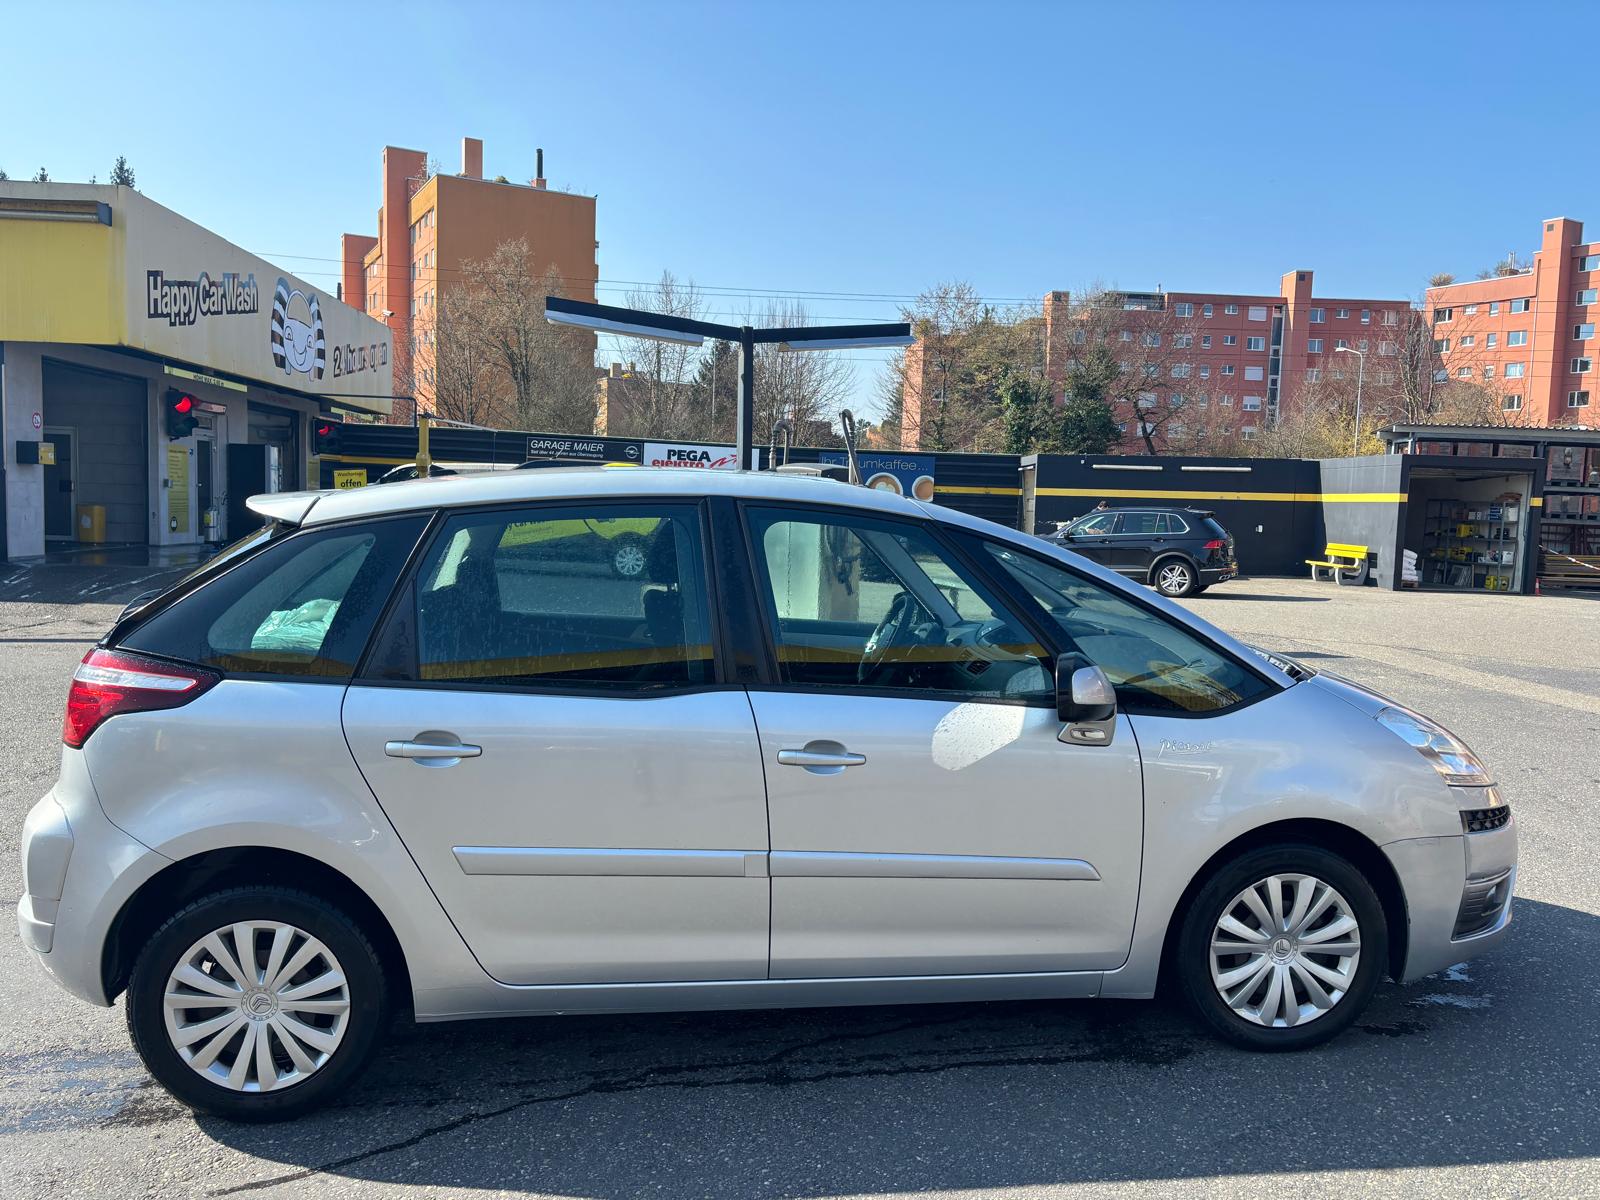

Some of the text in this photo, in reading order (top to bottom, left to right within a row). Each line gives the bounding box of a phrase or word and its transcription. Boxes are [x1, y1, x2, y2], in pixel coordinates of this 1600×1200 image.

[530, 440, 604, 452] GARAGE MAIER
[667, 449, 711, 462] PEGA
[340, 478, 362, 488] offen
